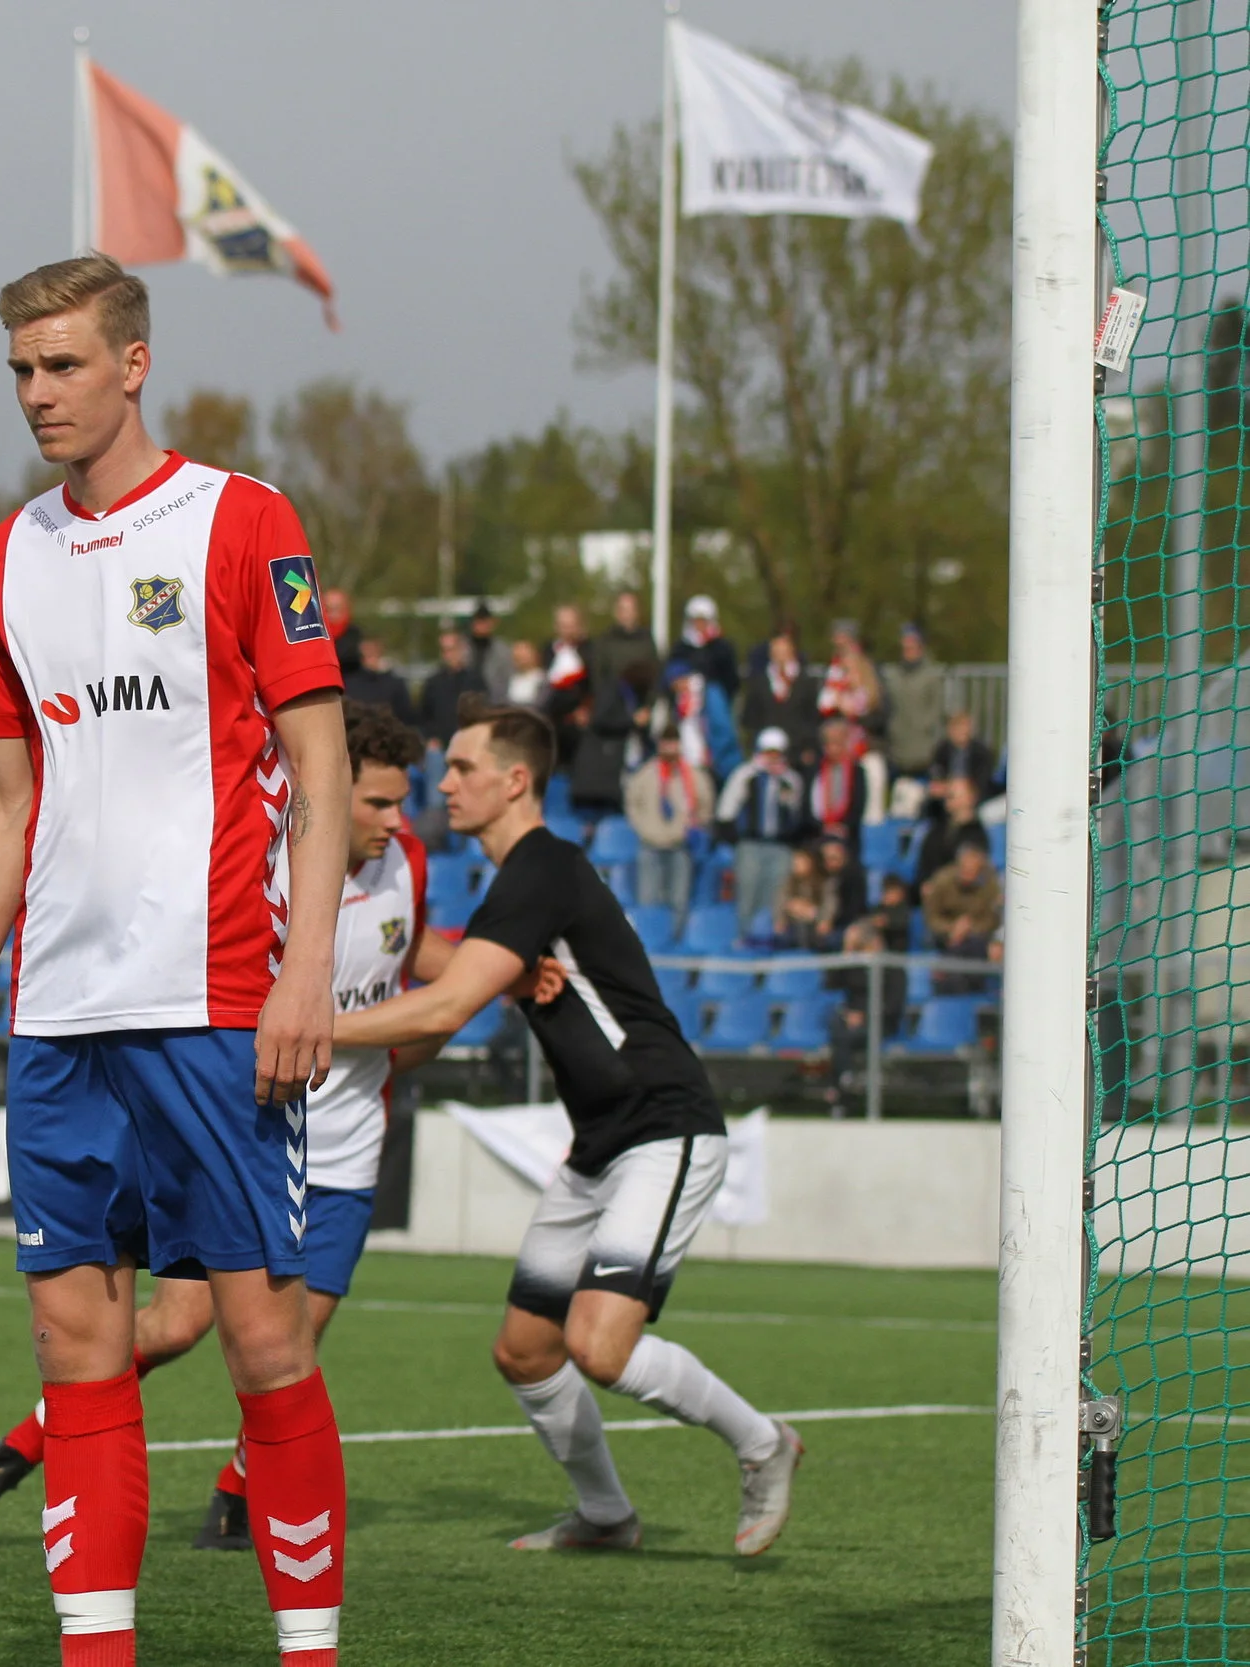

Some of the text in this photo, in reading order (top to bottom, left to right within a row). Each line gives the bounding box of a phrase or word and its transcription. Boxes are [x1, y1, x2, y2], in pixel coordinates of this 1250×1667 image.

[1093, 306, 1112, 357] OMBULL
[31, 506, 58, 537] SISSENER
[132, 491, 196, 532] SISSENER
[70, 530, 124, 557] hummel
[144, 590, 169, 612] LYN
